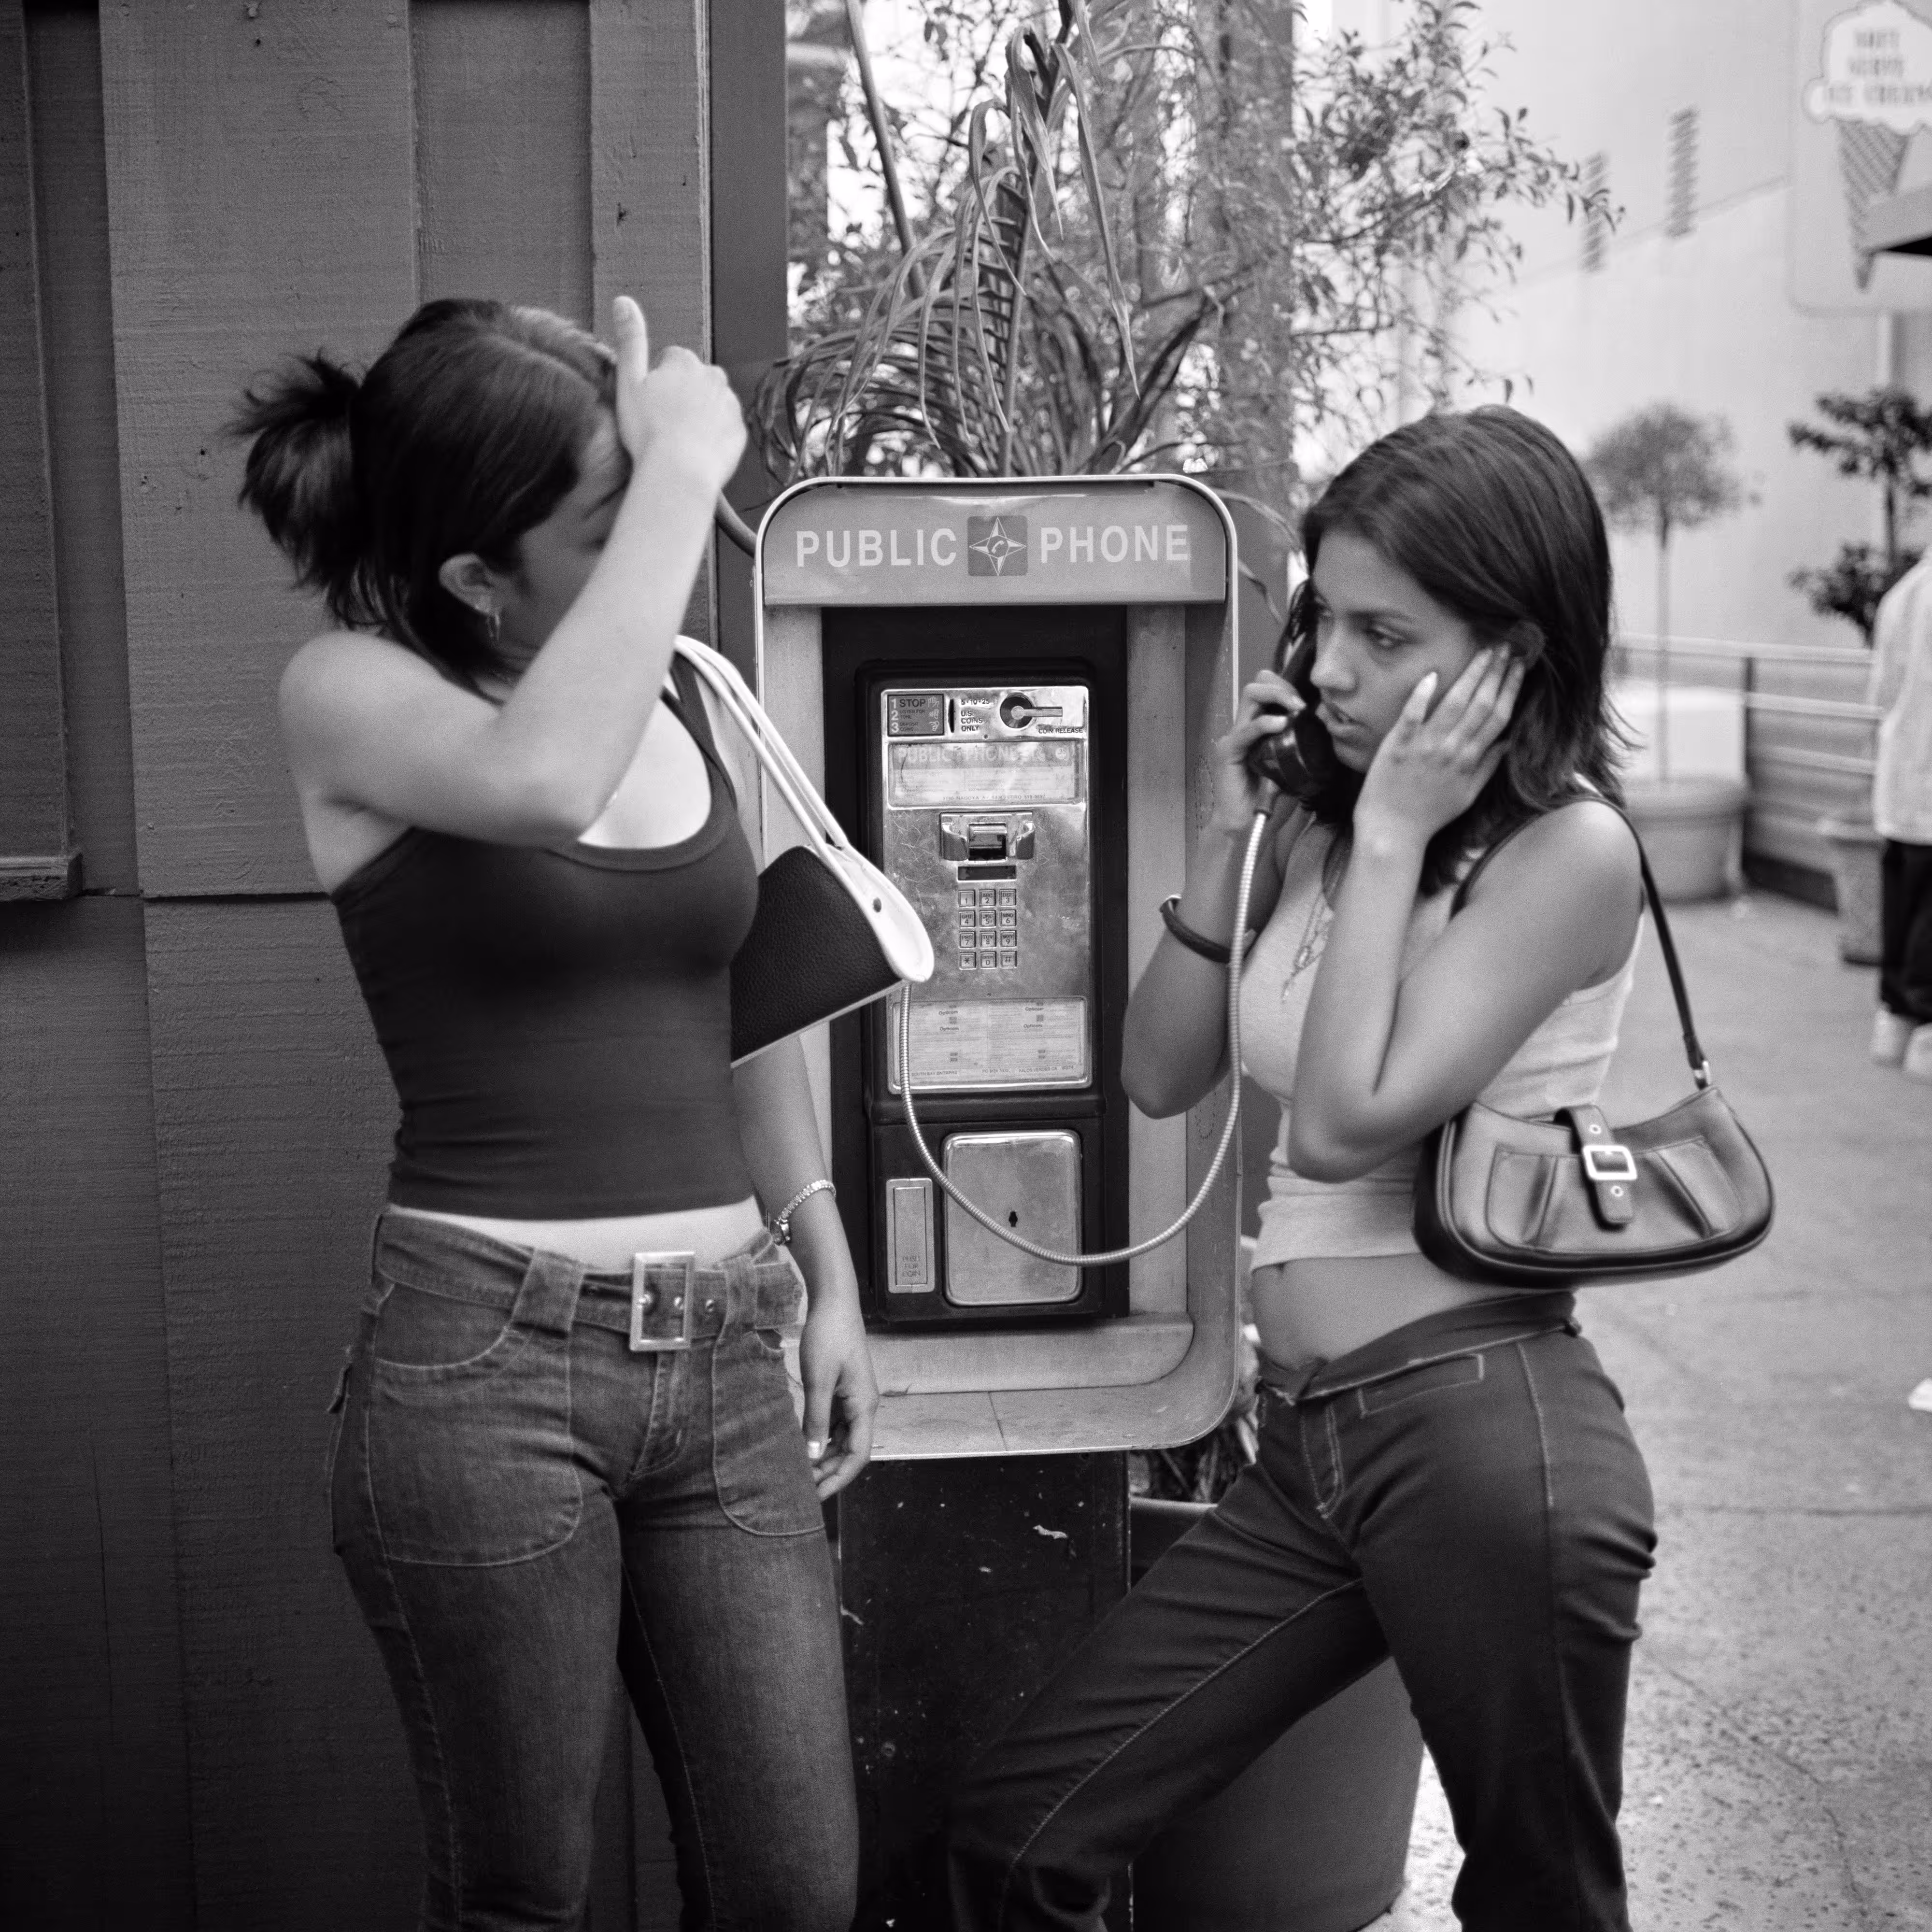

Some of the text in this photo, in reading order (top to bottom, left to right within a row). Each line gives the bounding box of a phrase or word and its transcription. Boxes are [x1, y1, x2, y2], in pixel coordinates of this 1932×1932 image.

[796, 525, 1189, 568] PUBLIC PHONE
[891, 698, 926, 709] 1 STOP
[891, 710, 898, 721] 2
[891, 722, 898, 733] 3
